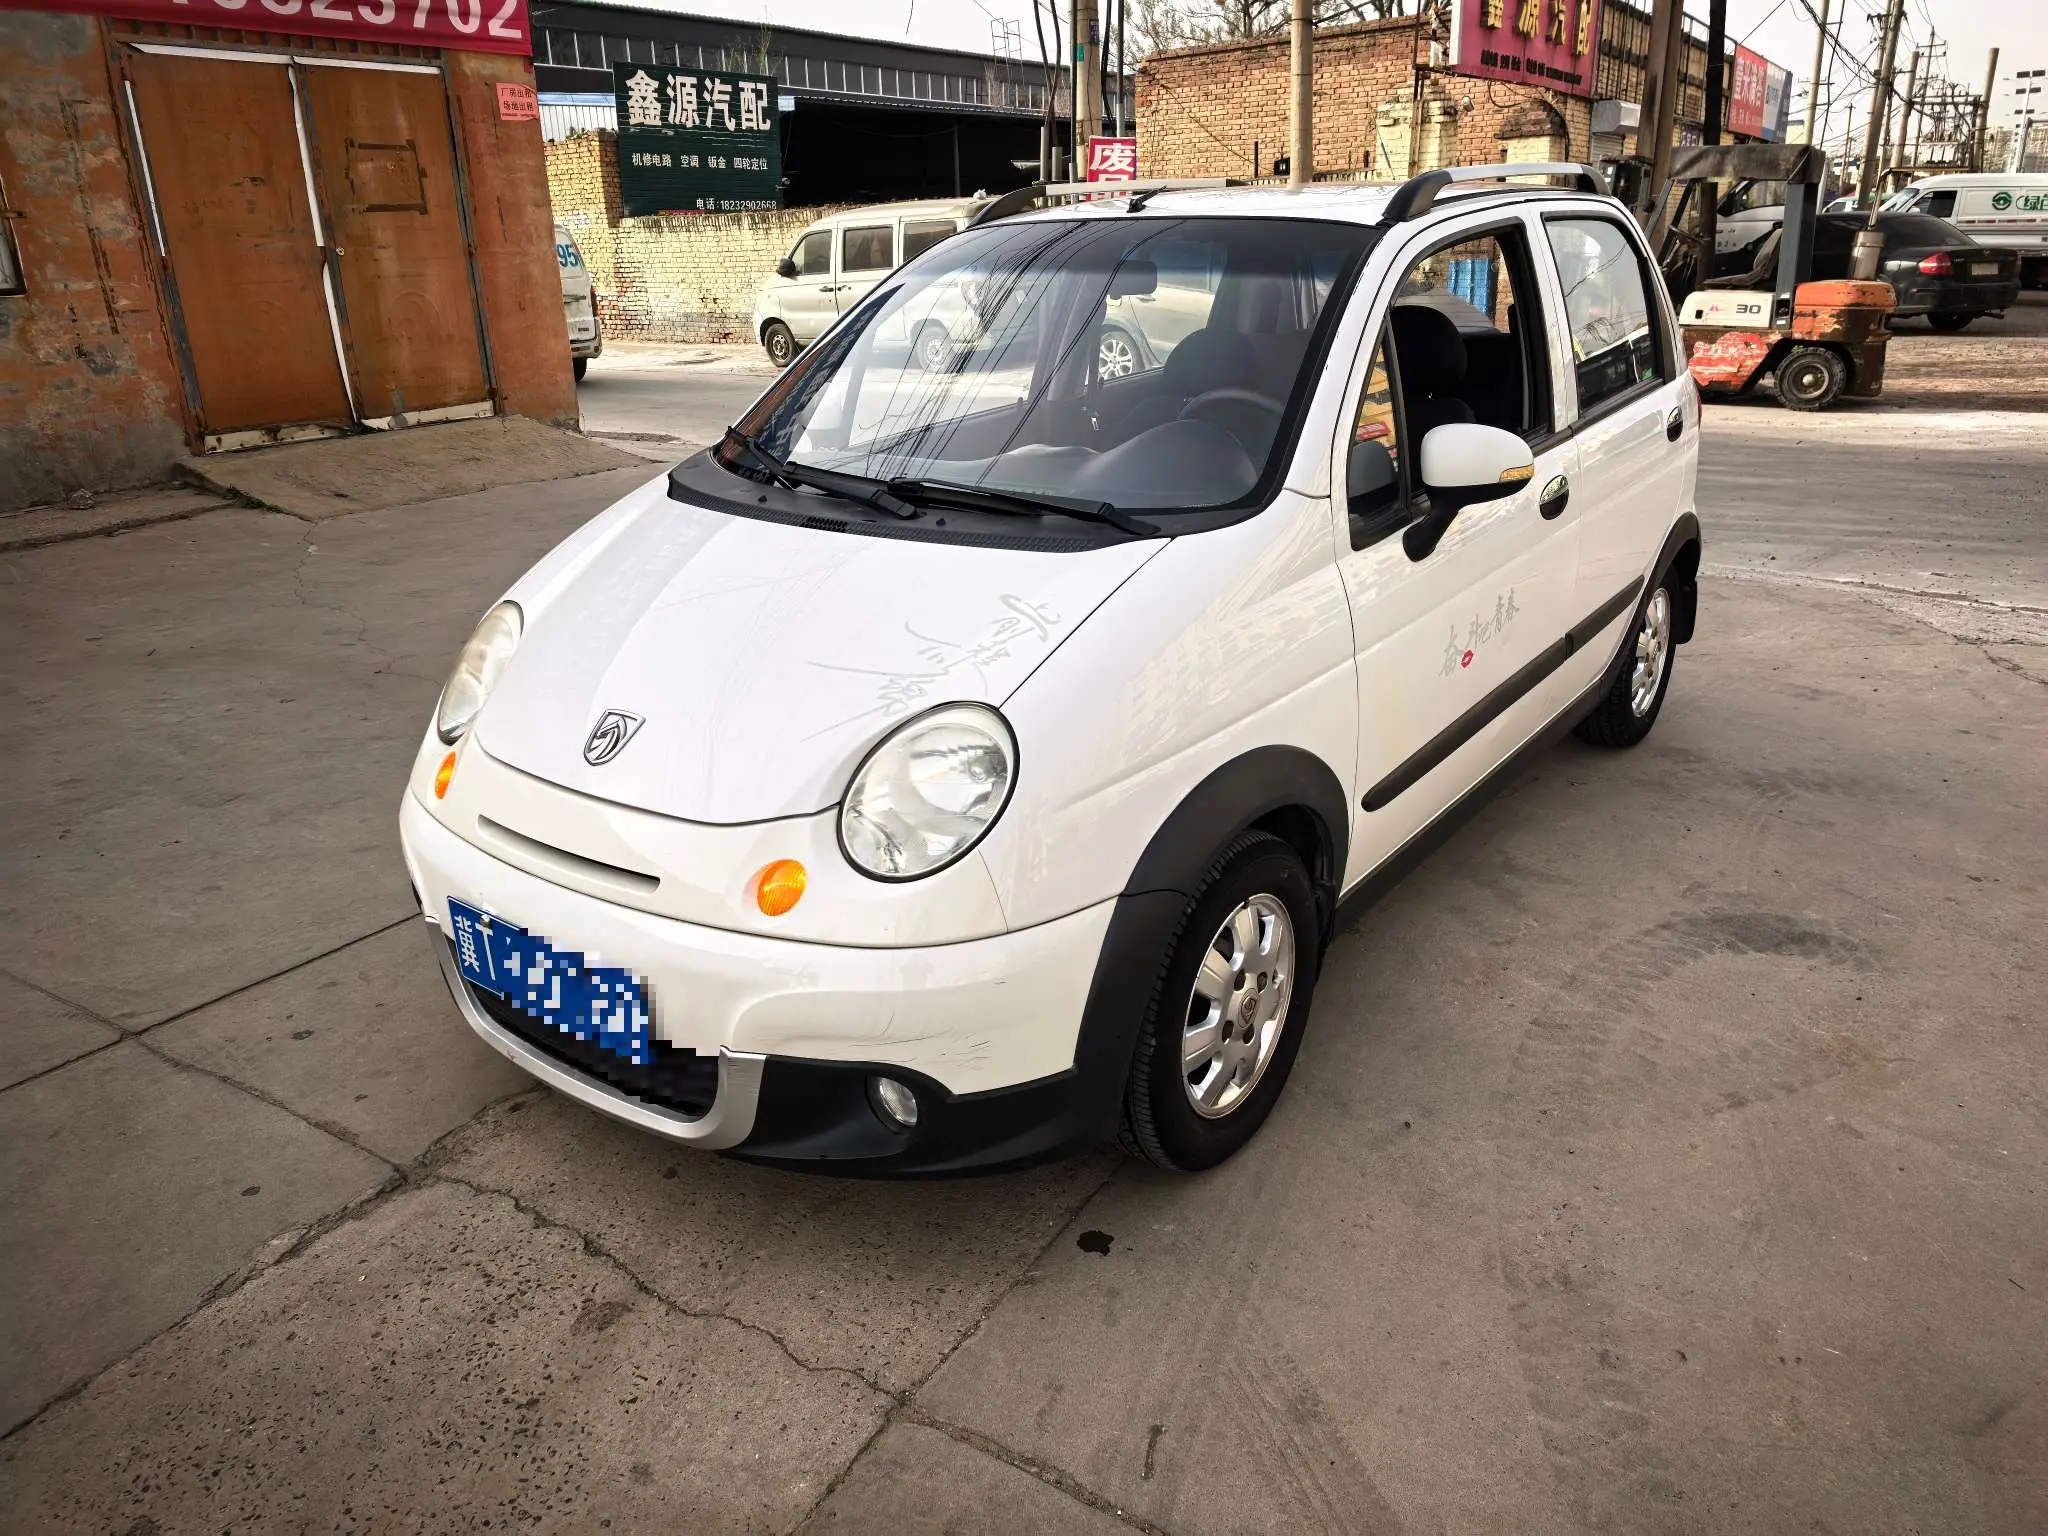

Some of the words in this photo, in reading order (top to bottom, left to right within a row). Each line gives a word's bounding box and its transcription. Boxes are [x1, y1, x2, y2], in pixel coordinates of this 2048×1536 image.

[625, 69, 771, 131] 鑫源汽配
[632, 152, 672, 168] 机修电路
[680, 154, 699, 168] 空调
[708, 155, 727, 169] 钣金
[734, 157, 768, 171] 四轮定位
[557, 244, 580, 268] 95
[1736, 304, 1761, 314] 30
